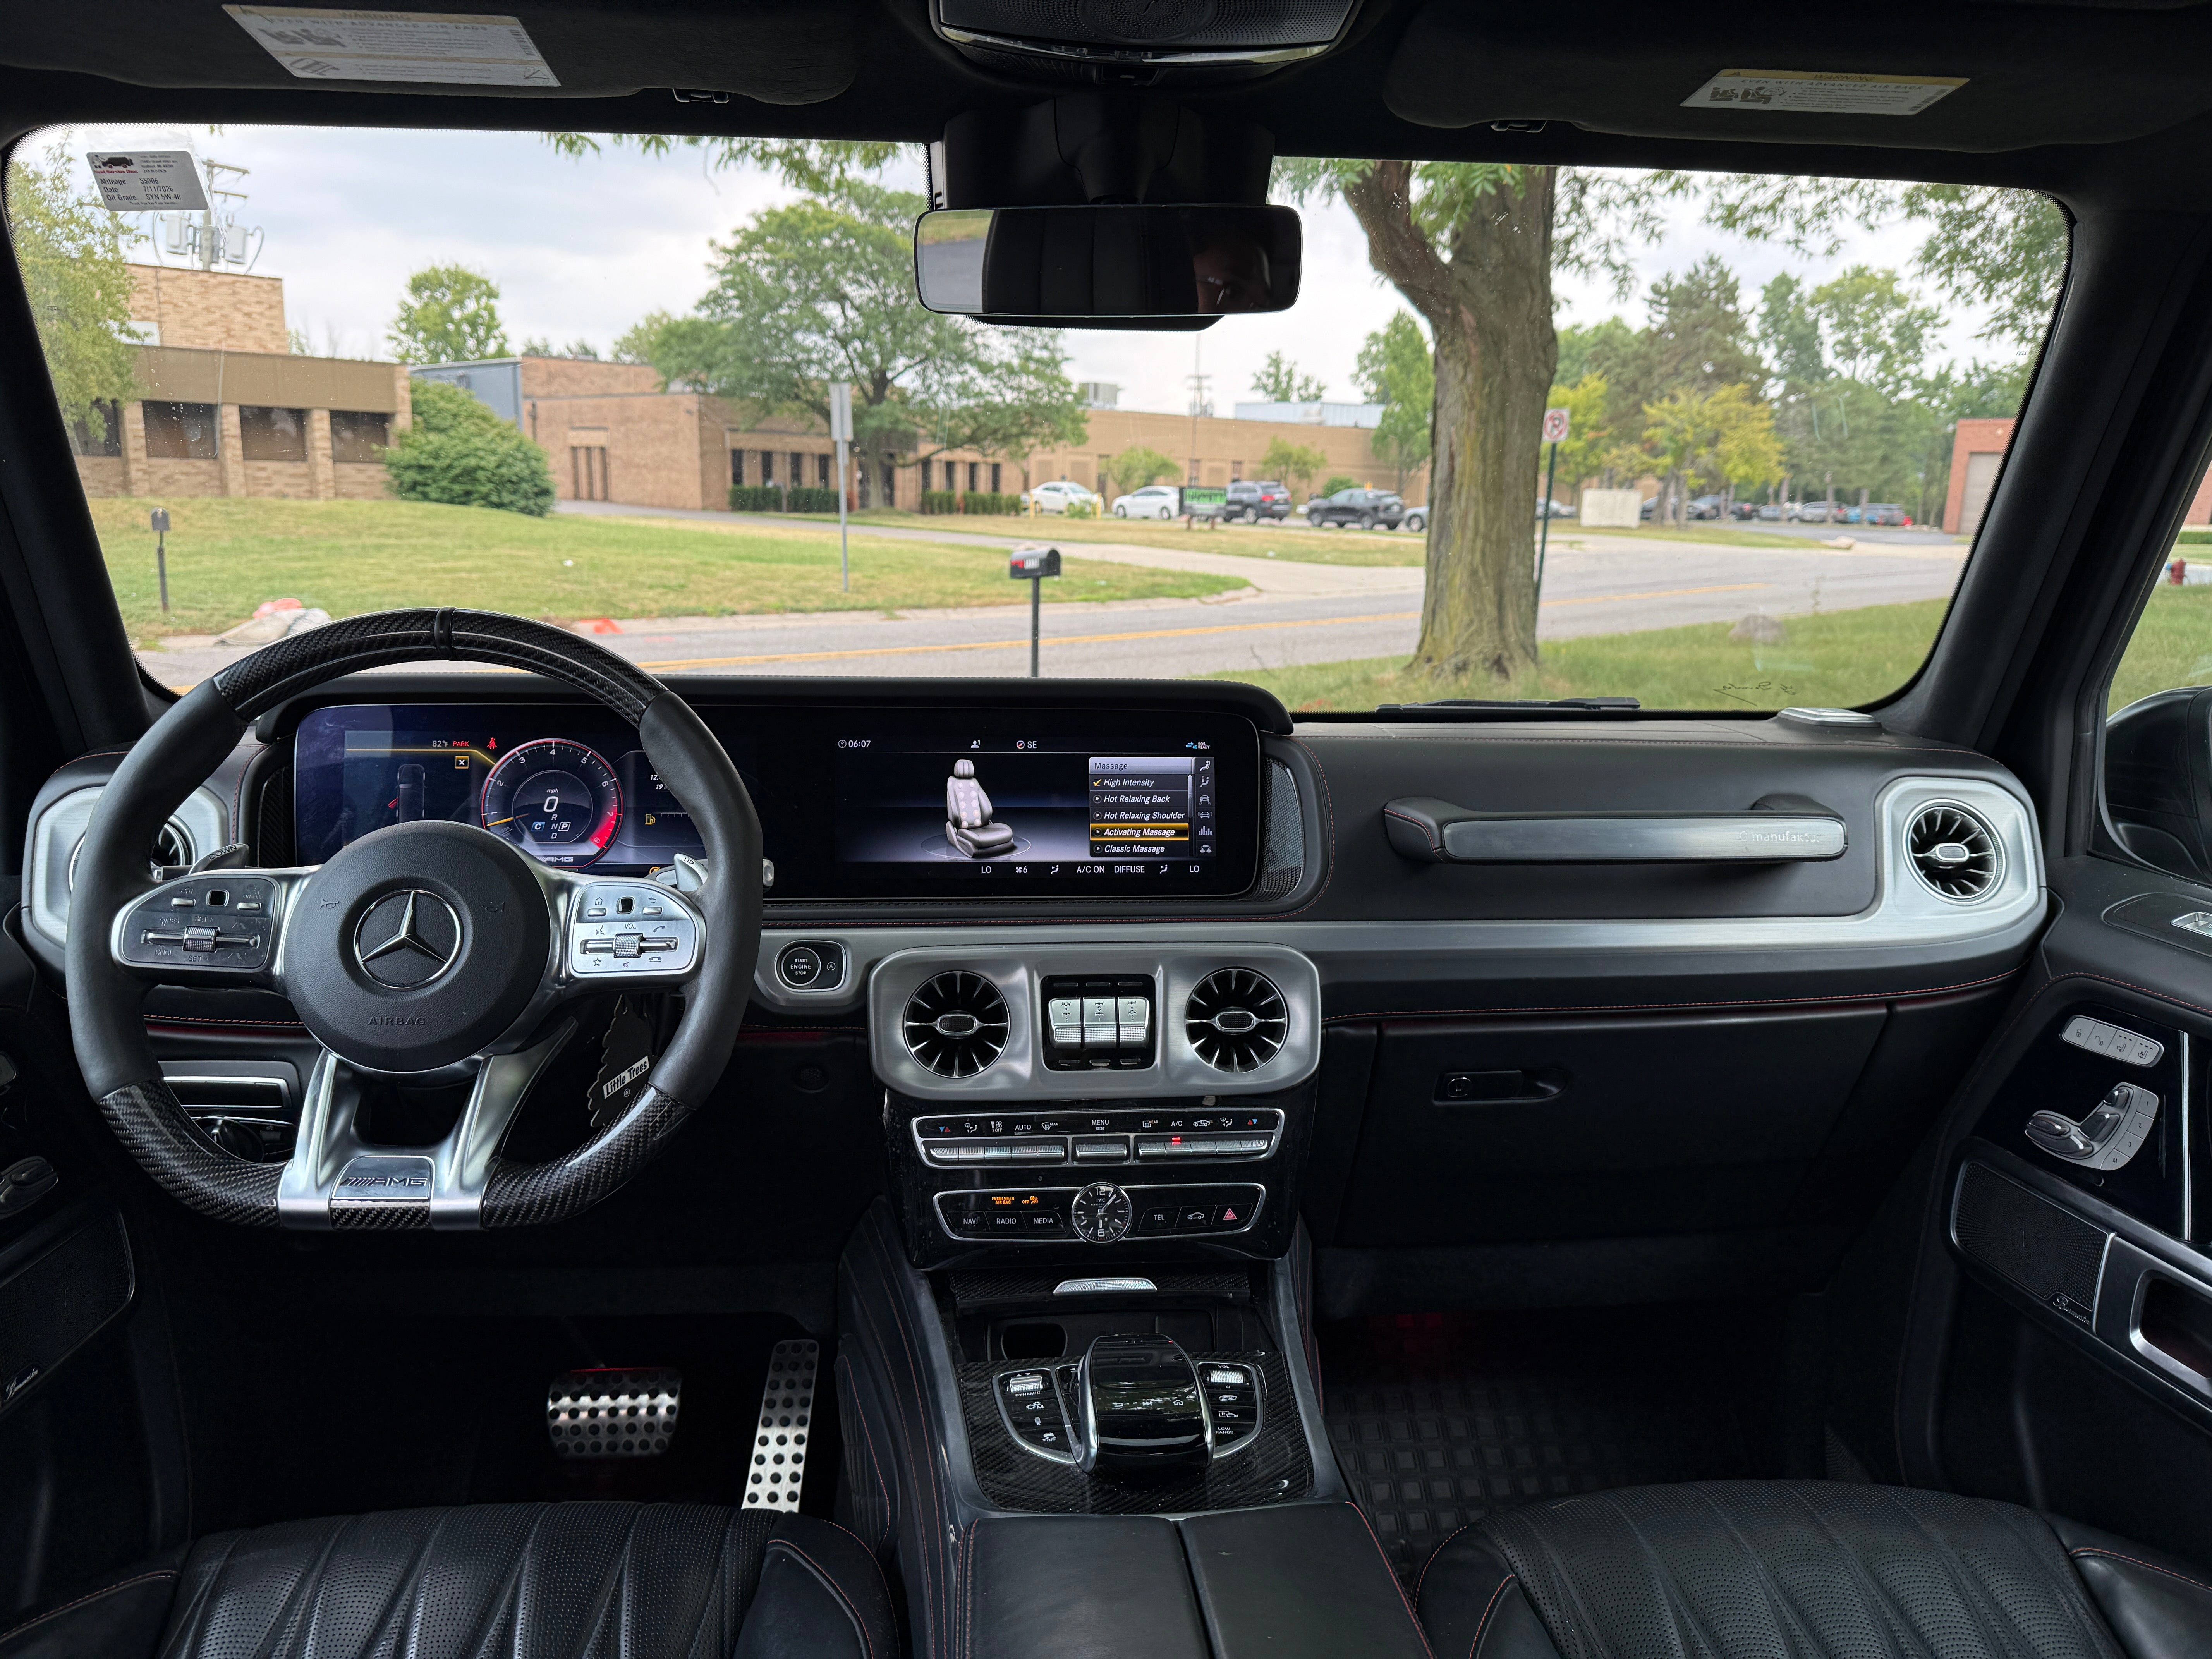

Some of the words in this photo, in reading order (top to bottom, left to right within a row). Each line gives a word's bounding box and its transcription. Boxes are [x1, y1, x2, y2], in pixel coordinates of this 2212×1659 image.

[848, 740, 871, 748] 06:07
[1094, 763, 1128, 771] Massage
[1104, 779, 1120, 787] High
[1122, 779, 1154, 787] Intensity
[543, 796, 559, 812] 0
[1119, 795, 1150, 804] Relaxing
[1119, 812, 1150, 821] Relaxing
[1104, 828, 1141, 837] Activating
[1142, 828, 1175, 837] Massage
[209, 845, 238, 860] DOWN
[1132, 845, 1165, 854] Massage
[684, 857, 694, 865] UP
[1114, 865, 1145, 873] DIFFUSE
[368, 1016, 426, 1026] AIRBAG
[606, 1075, 626, 1096] Little
[627, 1061, 647, 1080] Trees
[1096, 1187, 1106, 1195] 12
[1097, 1228, 1105, 1237] 6
